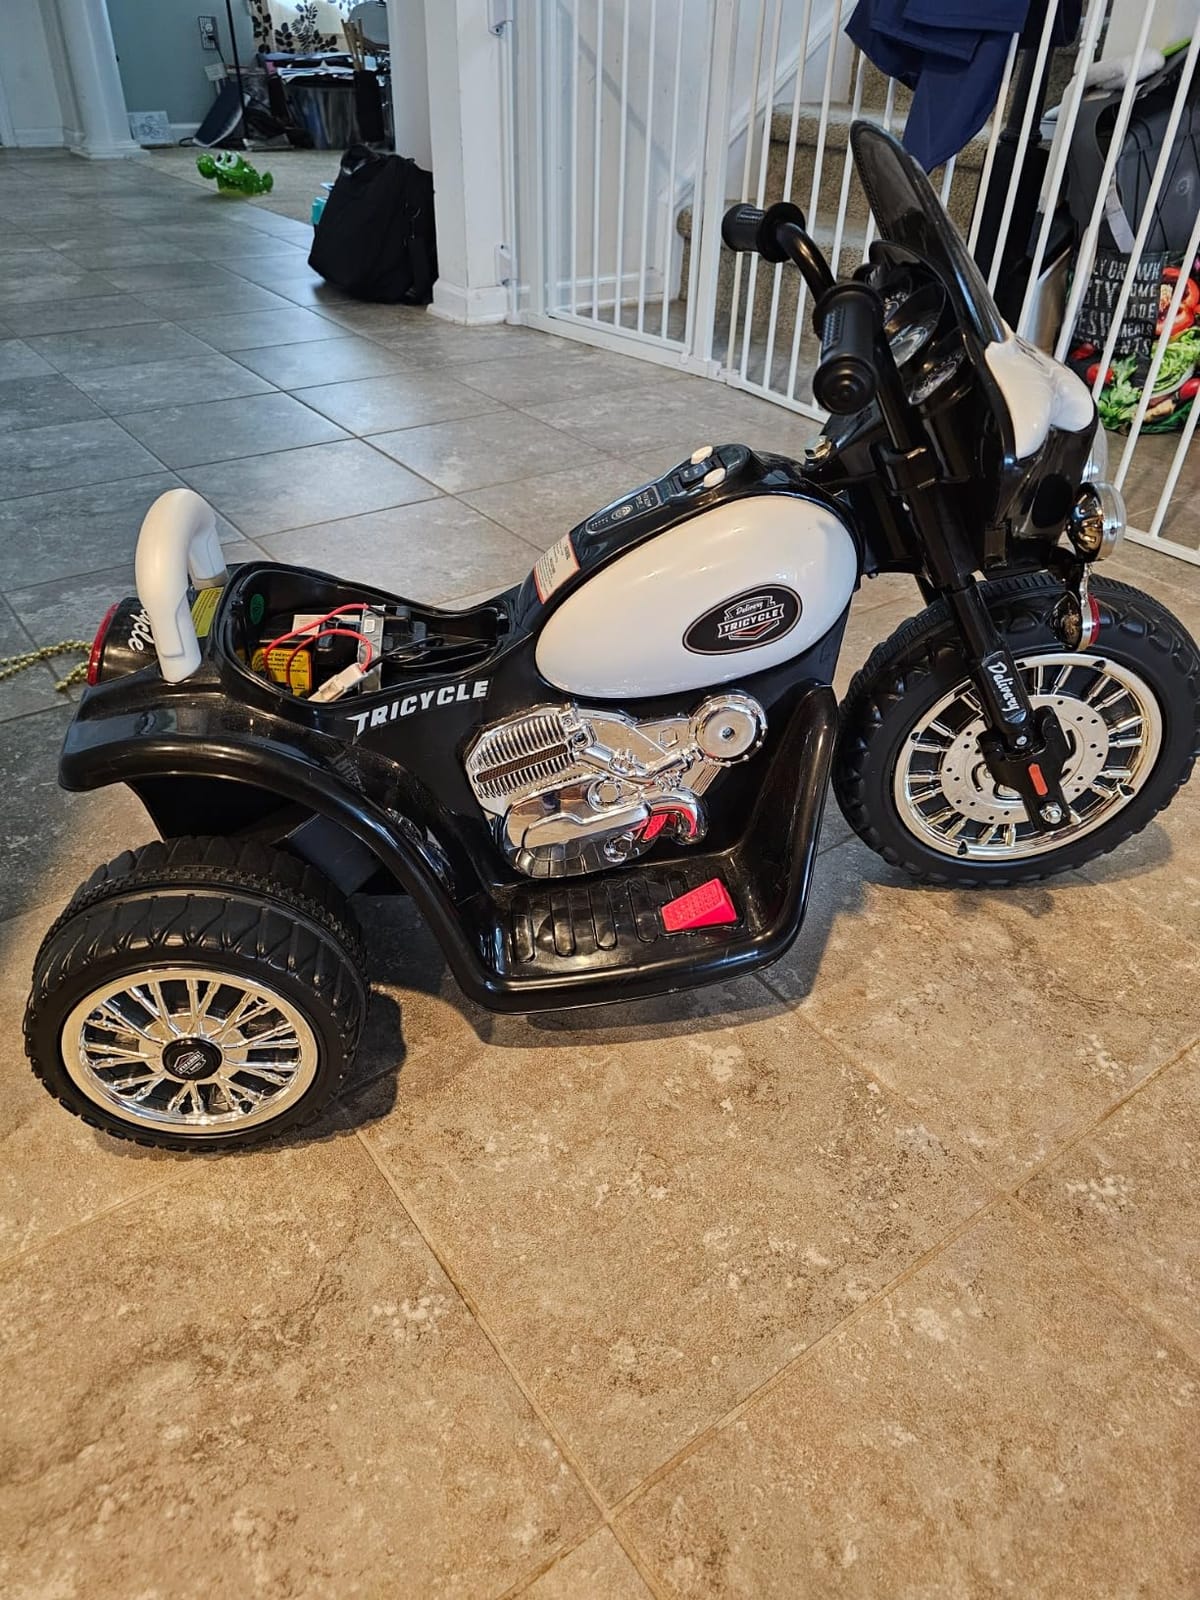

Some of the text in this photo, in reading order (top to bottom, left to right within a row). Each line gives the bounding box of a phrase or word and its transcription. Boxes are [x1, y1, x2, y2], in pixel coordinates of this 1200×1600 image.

[1130, 282, 1158, 298] OME
[723, 608, 779, 633] TRICYCLE
[987, 661, 1020, 712] Delivery
[345, 680, 489, 737] TRICYCLE
